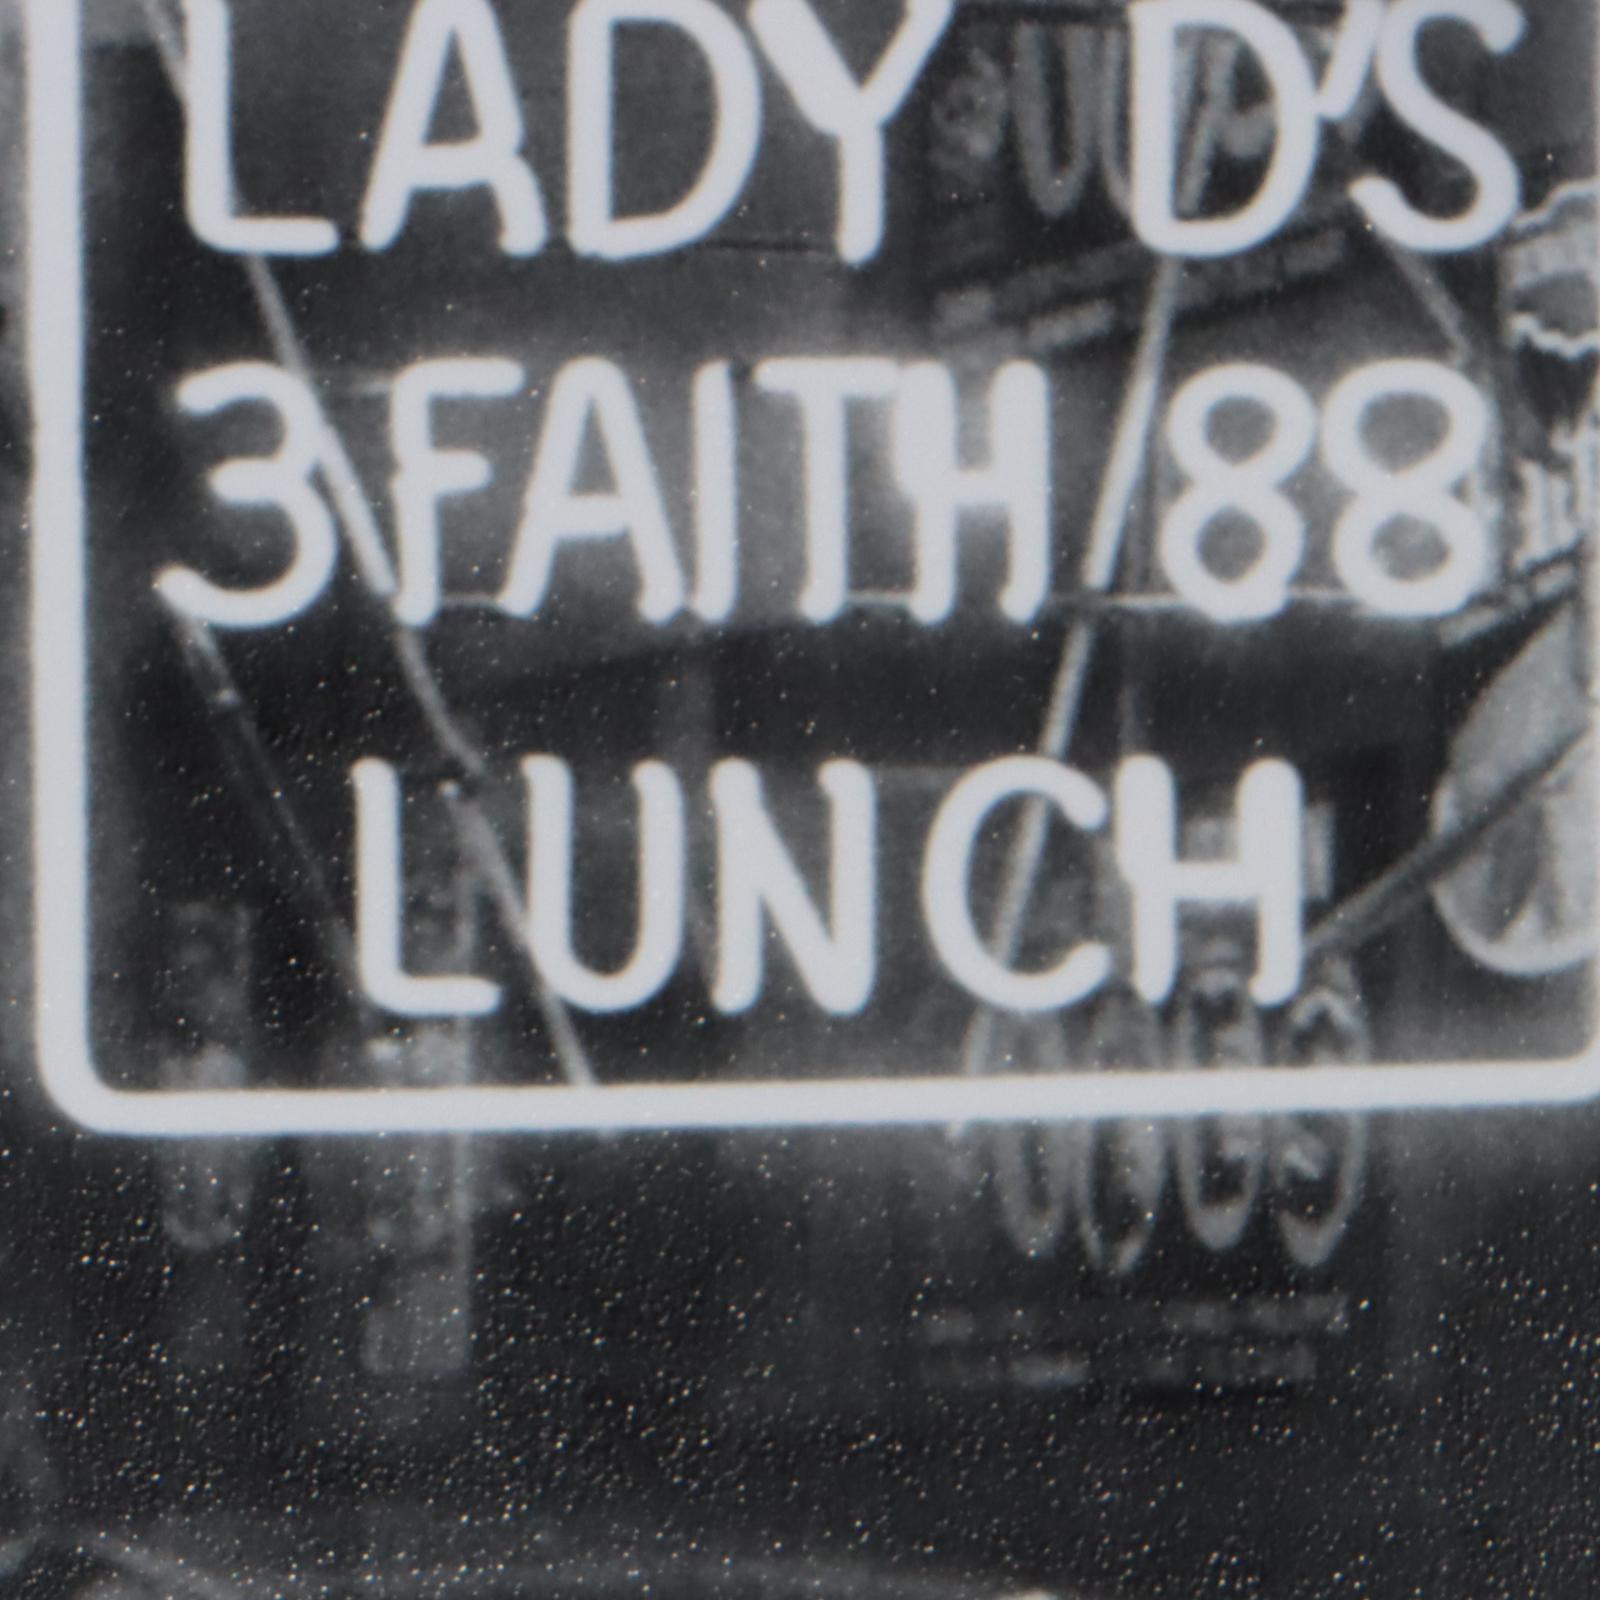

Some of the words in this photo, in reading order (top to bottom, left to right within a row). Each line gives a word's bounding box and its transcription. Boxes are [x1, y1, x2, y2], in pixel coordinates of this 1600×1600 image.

[185, 0, 955, 264] LADY
[1130, 0, 1526, 256] D'S
[1158, 360, 1490, 622] 88
[352, 757, 1302, 1020] LUNCH
